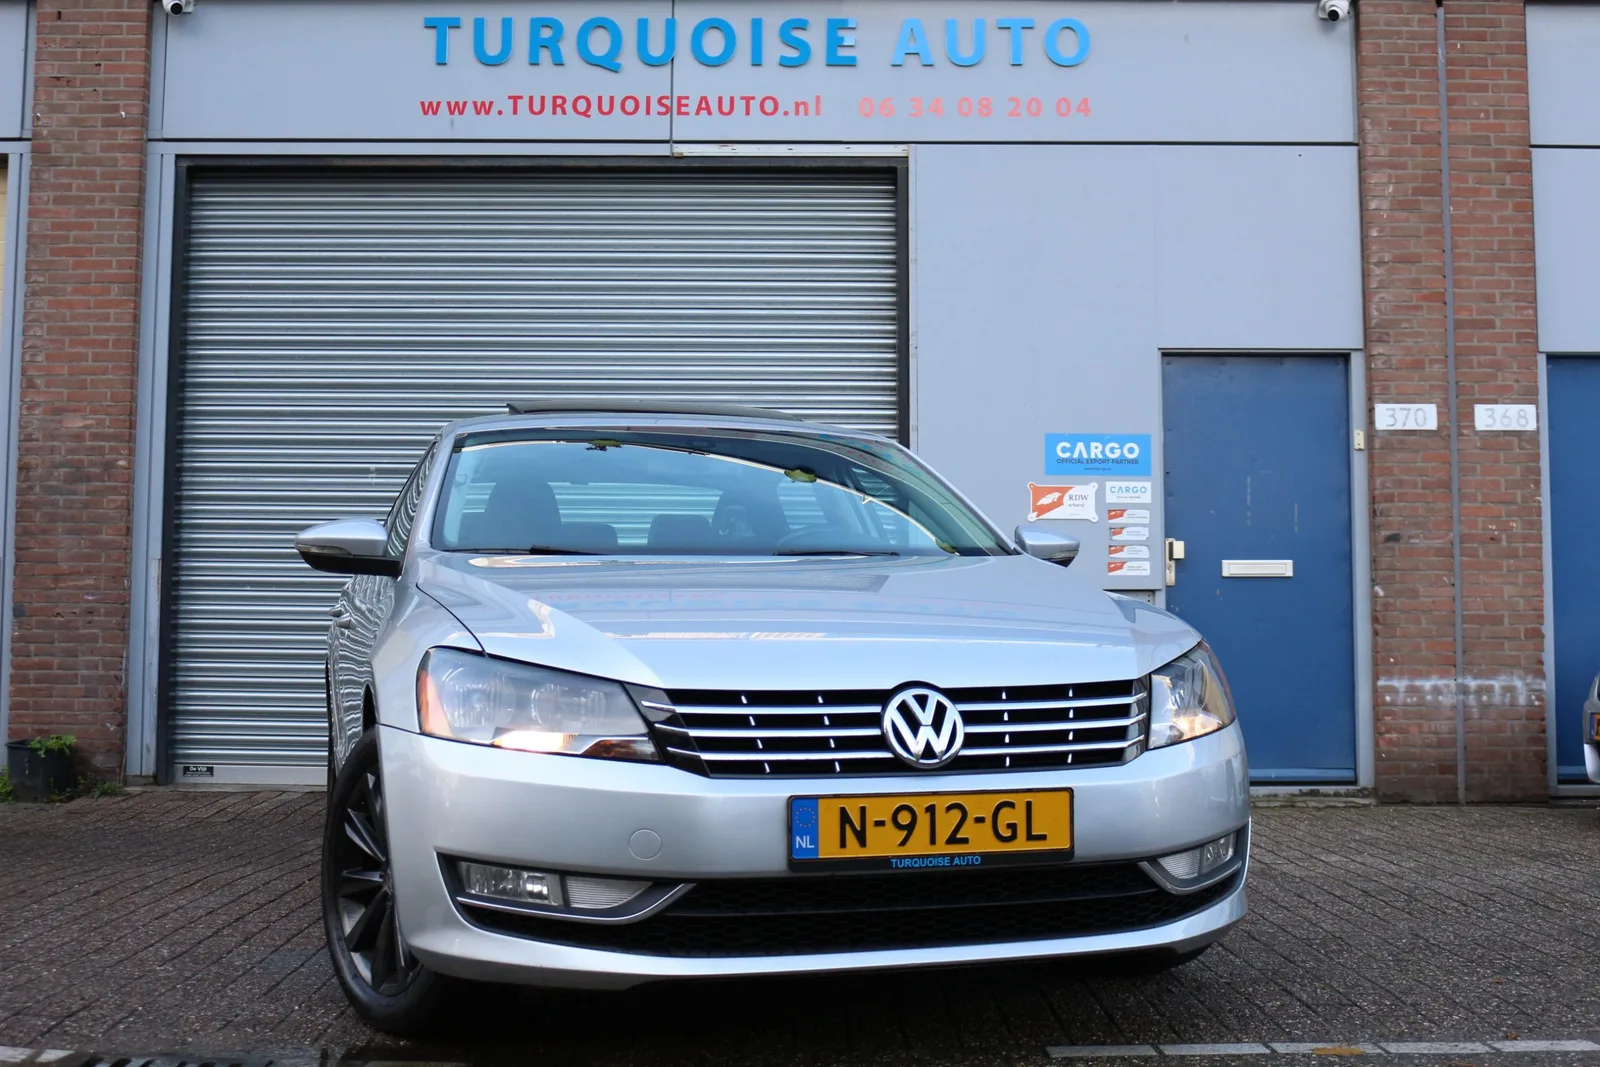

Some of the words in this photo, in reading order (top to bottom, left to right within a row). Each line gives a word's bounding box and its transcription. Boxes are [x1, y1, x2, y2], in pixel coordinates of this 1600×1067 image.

[424, 16, 857, 73] TURQUOISE
[890, 17, 1091, 67] AUTO
[420, 94, 822, 118] www.TURQUOISEAUTO.nl
[859, 96, 896, 118] 06
[908, 96, 945, 118] 34
[957, 96, 994, 118] 08
[1007, 96, 1043, 118] 20
[1055, 96, 1092, 118] 04
[1385, 407, 1428, 428] 370
[1484, 408, 1530, 428] 368
[1056, 441, 1140, 459] CARGO
[1109, 486, 1147, 494] CARGO
[838, 800, 1048, 849] N-912-GL
[795, 835, 815, 849] NL
[891, 857, 951, 868] TURQUOISE
[953, 855, 981, 866] AUTO
